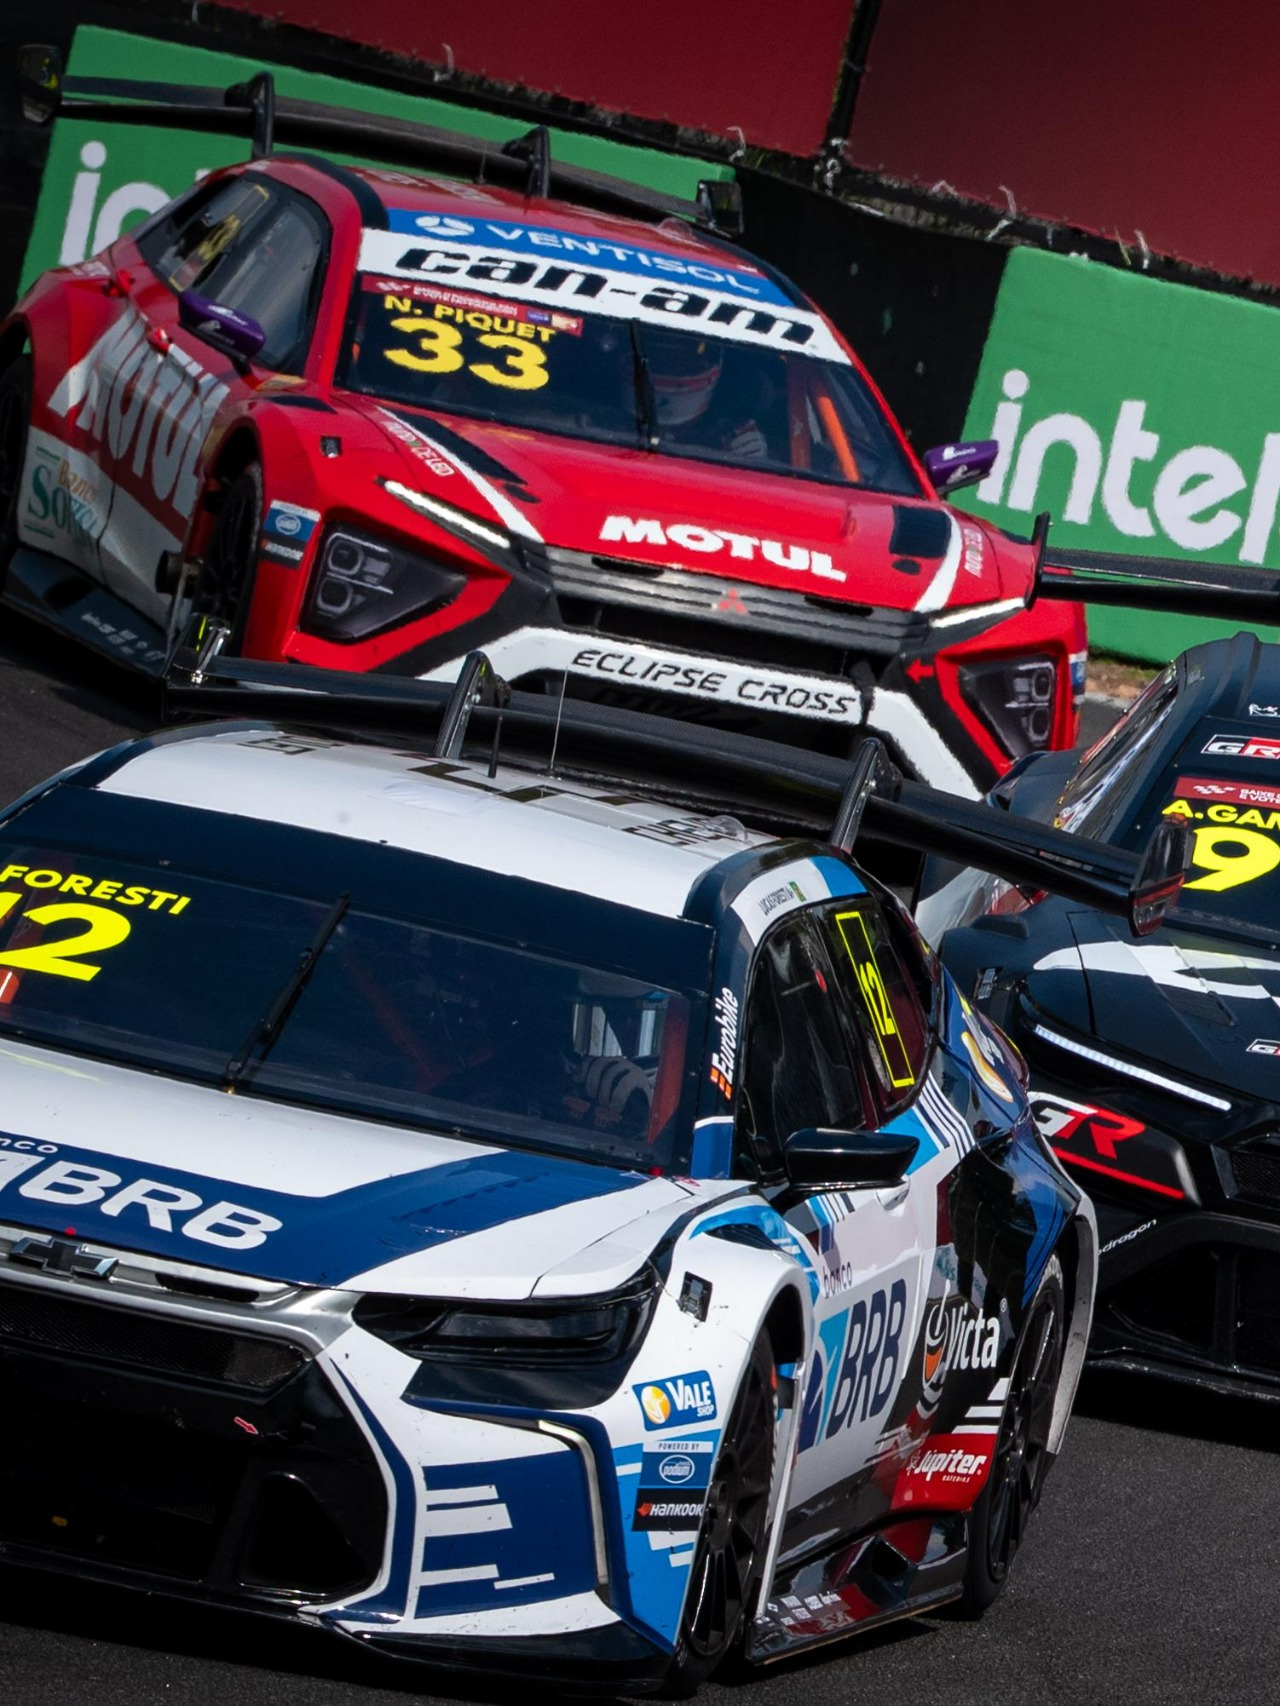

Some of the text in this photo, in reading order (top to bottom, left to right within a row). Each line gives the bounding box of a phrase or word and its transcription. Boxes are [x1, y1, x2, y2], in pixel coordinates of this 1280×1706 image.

[486, 224, 760, 294] VENTISOL
[396, 248, 815, 346] can-am
[433, 303, 556, 343] PIQUET
[383, 317, 550, 391] 33
[598, 514, 848, 584] MOTUL
[572, 649, 857, 714] ECLIPSE CROSS
[711, 987, 739, 1085] Eurobike
[1026, 1091, 1146, 1160] GR
[822, 1261, 853, 1300] banco
[825, 1278, 907, 1441] BRB
[666, 1379, 712, 1412] VALE
[696, 1404, 715, 1418] SHOP
[658, 1442, 700, 1451] POWERED BY
